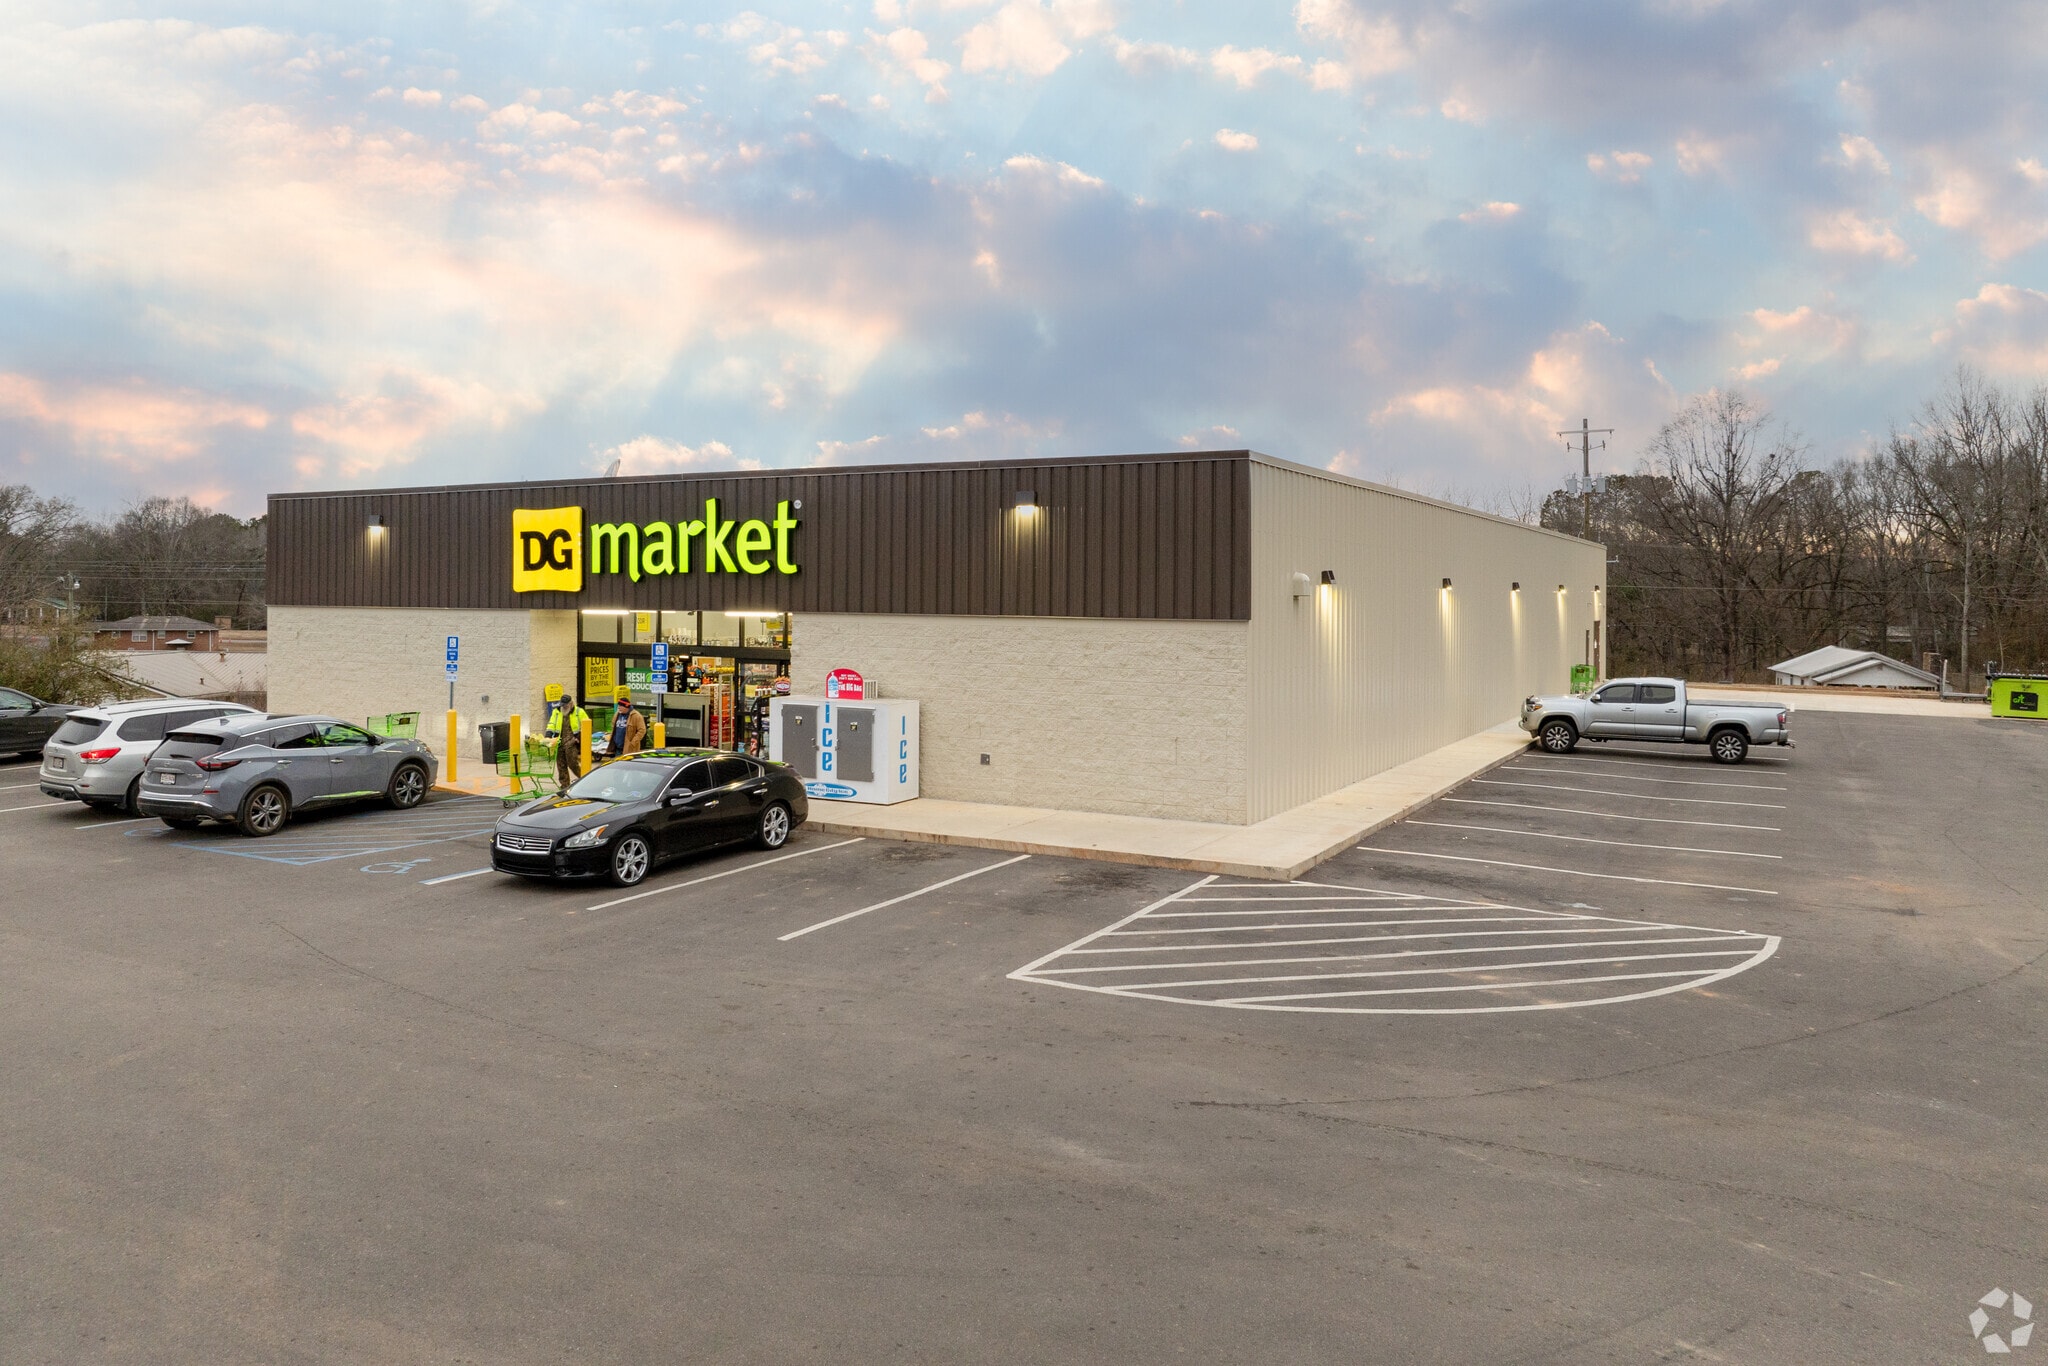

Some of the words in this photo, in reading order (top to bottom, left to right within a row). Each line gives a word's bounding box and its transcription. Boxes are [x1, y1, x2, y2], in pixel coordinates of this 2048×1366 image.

[520, 528, 573, 571] DG
[590, 497, 798, 583] market
[591, 657, 609, 665] LOW
[590, 666, 609, 674] PRICES
[626, 682, 652, 690] RODUC
